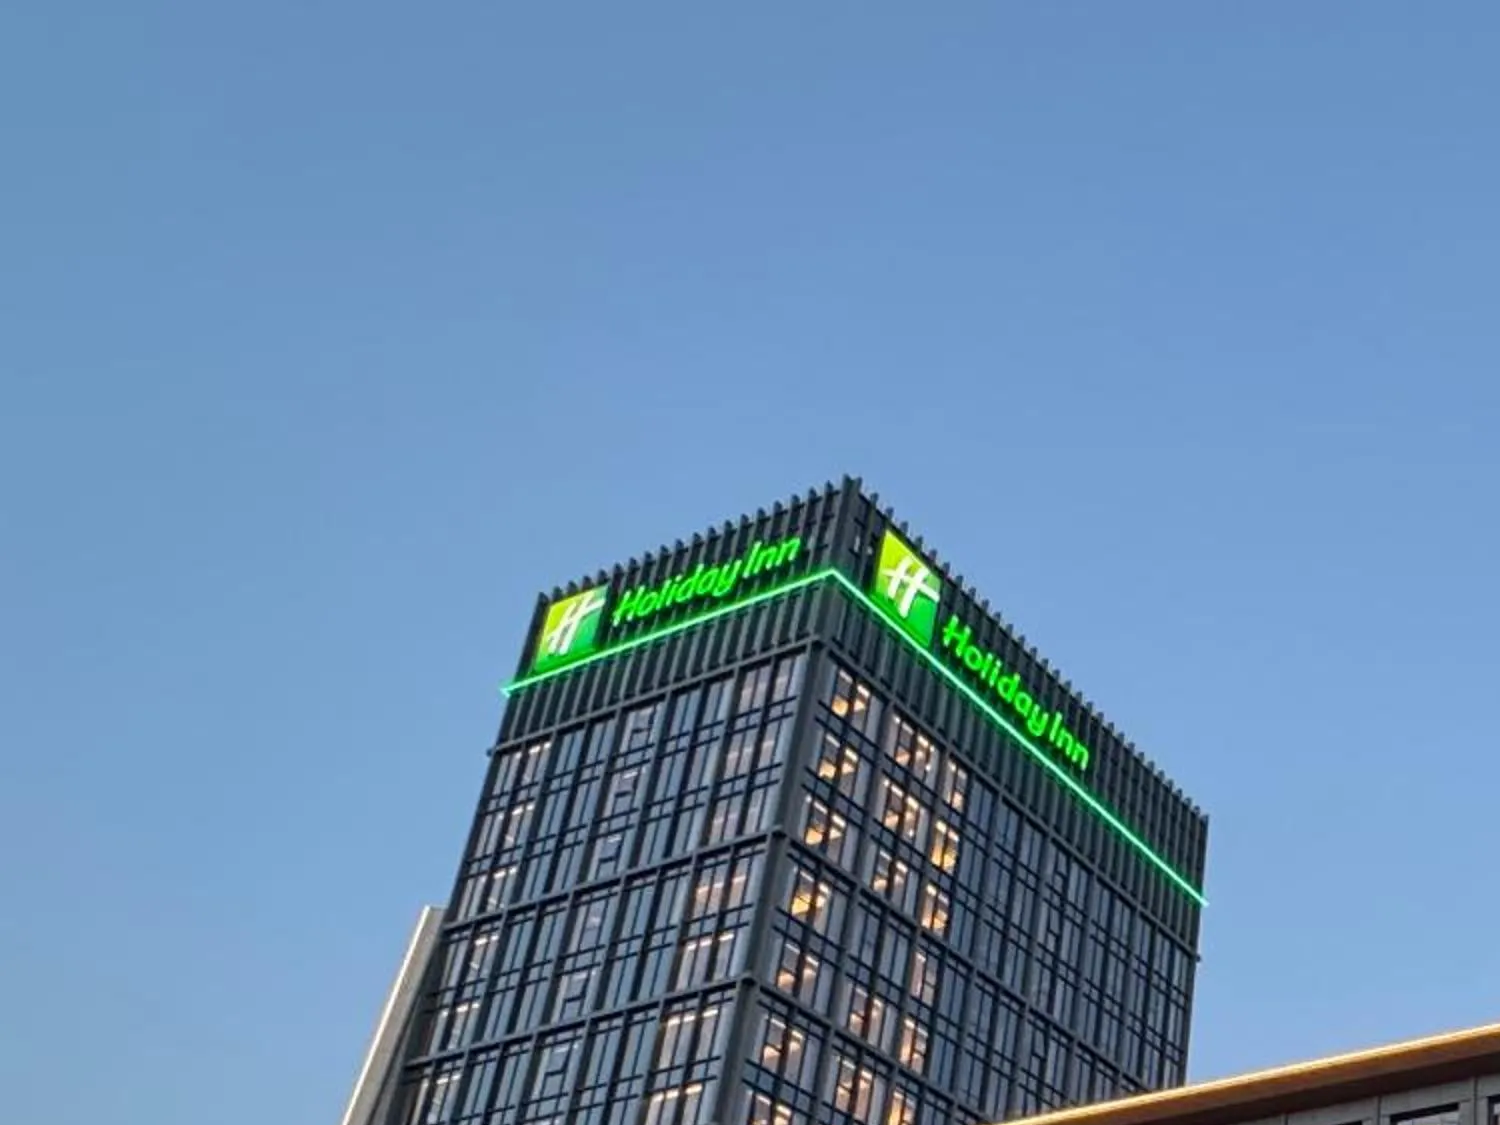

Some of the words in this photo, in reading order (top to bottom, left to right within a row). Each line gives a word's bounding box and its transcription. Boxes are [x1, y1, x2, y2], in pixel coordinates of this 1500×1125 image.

[613, 559, 742, 627] Holiday
[742, 537, 800, 578] Inn
[942, 613, 1049, 737] Holiday
[1049, 711, 1090, 772] Inn
